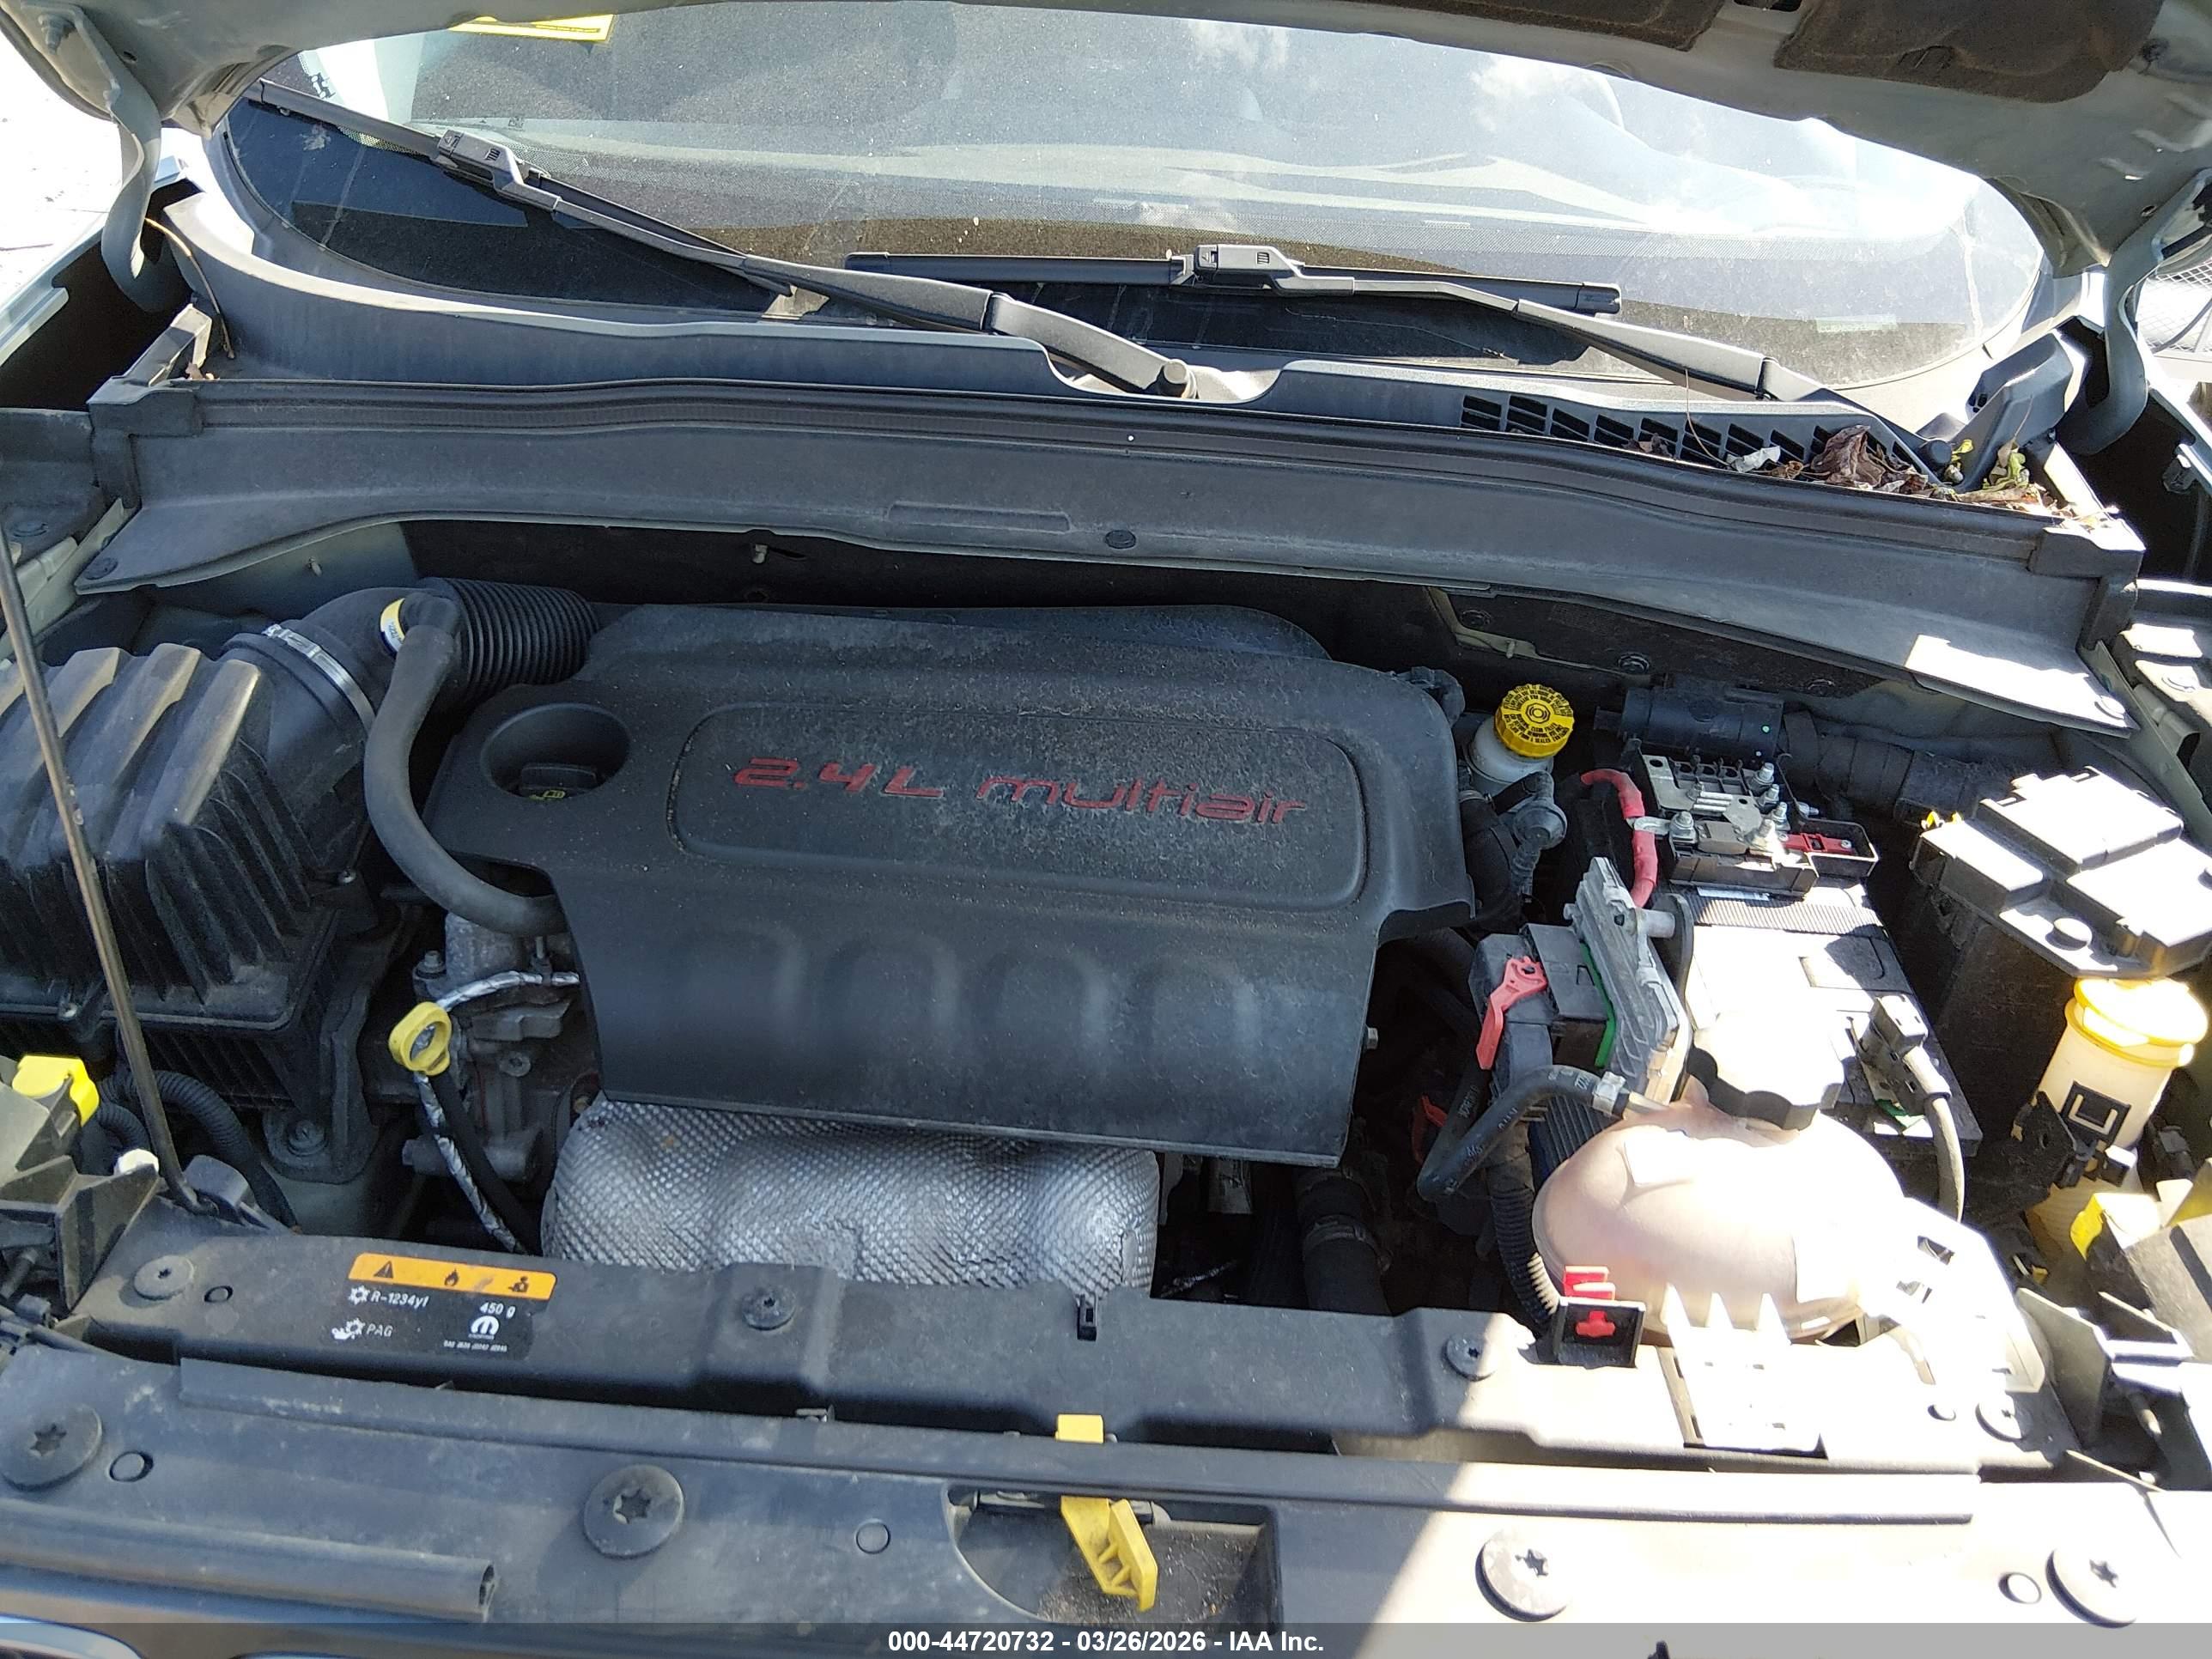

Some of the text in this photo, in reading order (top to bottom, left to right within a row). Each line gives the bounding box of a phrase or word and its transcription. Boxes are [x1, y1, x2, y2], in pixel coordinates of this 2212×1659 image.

[734, 757, 1306, 824] 2.4L multiair
[479, 1302, 516, 1319] 450 g
[367, 1322, 394, 1338] PAG
